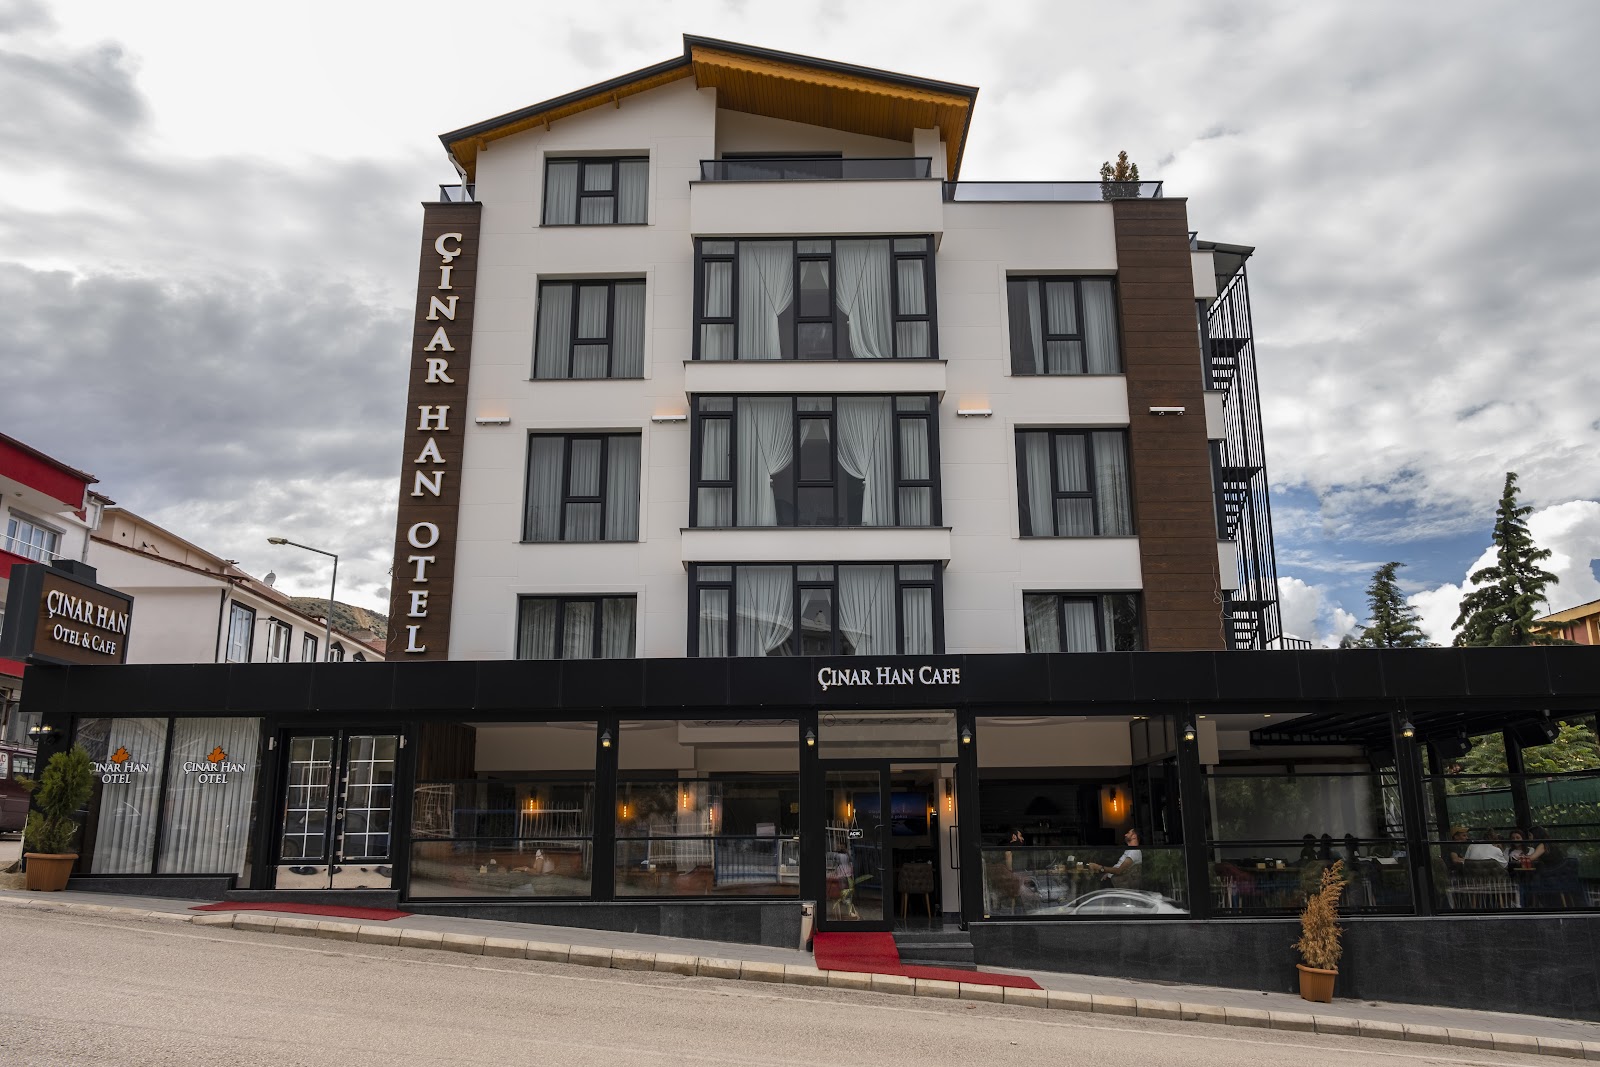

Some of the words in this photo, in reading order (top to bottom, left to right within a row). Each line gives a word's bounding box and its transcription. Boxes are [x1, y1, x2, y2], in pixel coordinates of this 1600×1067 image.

[424, 232, 462, 384] ÇINAR
[411, 405, 451, 497] HAN
[404, 522, 440, 653] OTEL
[47, 589, 94, 625] ÇINAR
[96, 604, 129, 635] HAN
[53, 623, 80, 646] OTEL
[81, 632, 90, 649] &
[91, 635, 117, 655] CAFE
[817, 667, 873, 691] ÇINAR
[876, 667, 914, 685] HAN
[918, 666, 961, 685] CAFE
[101, 773, 131, 784] OTEL
[124, 762, 149, 773] HAN
[183, 761, 219, 774] ÇINAR
[220, 762, 247, 773] HAN
[198, 773, 228, 784] OTEL
